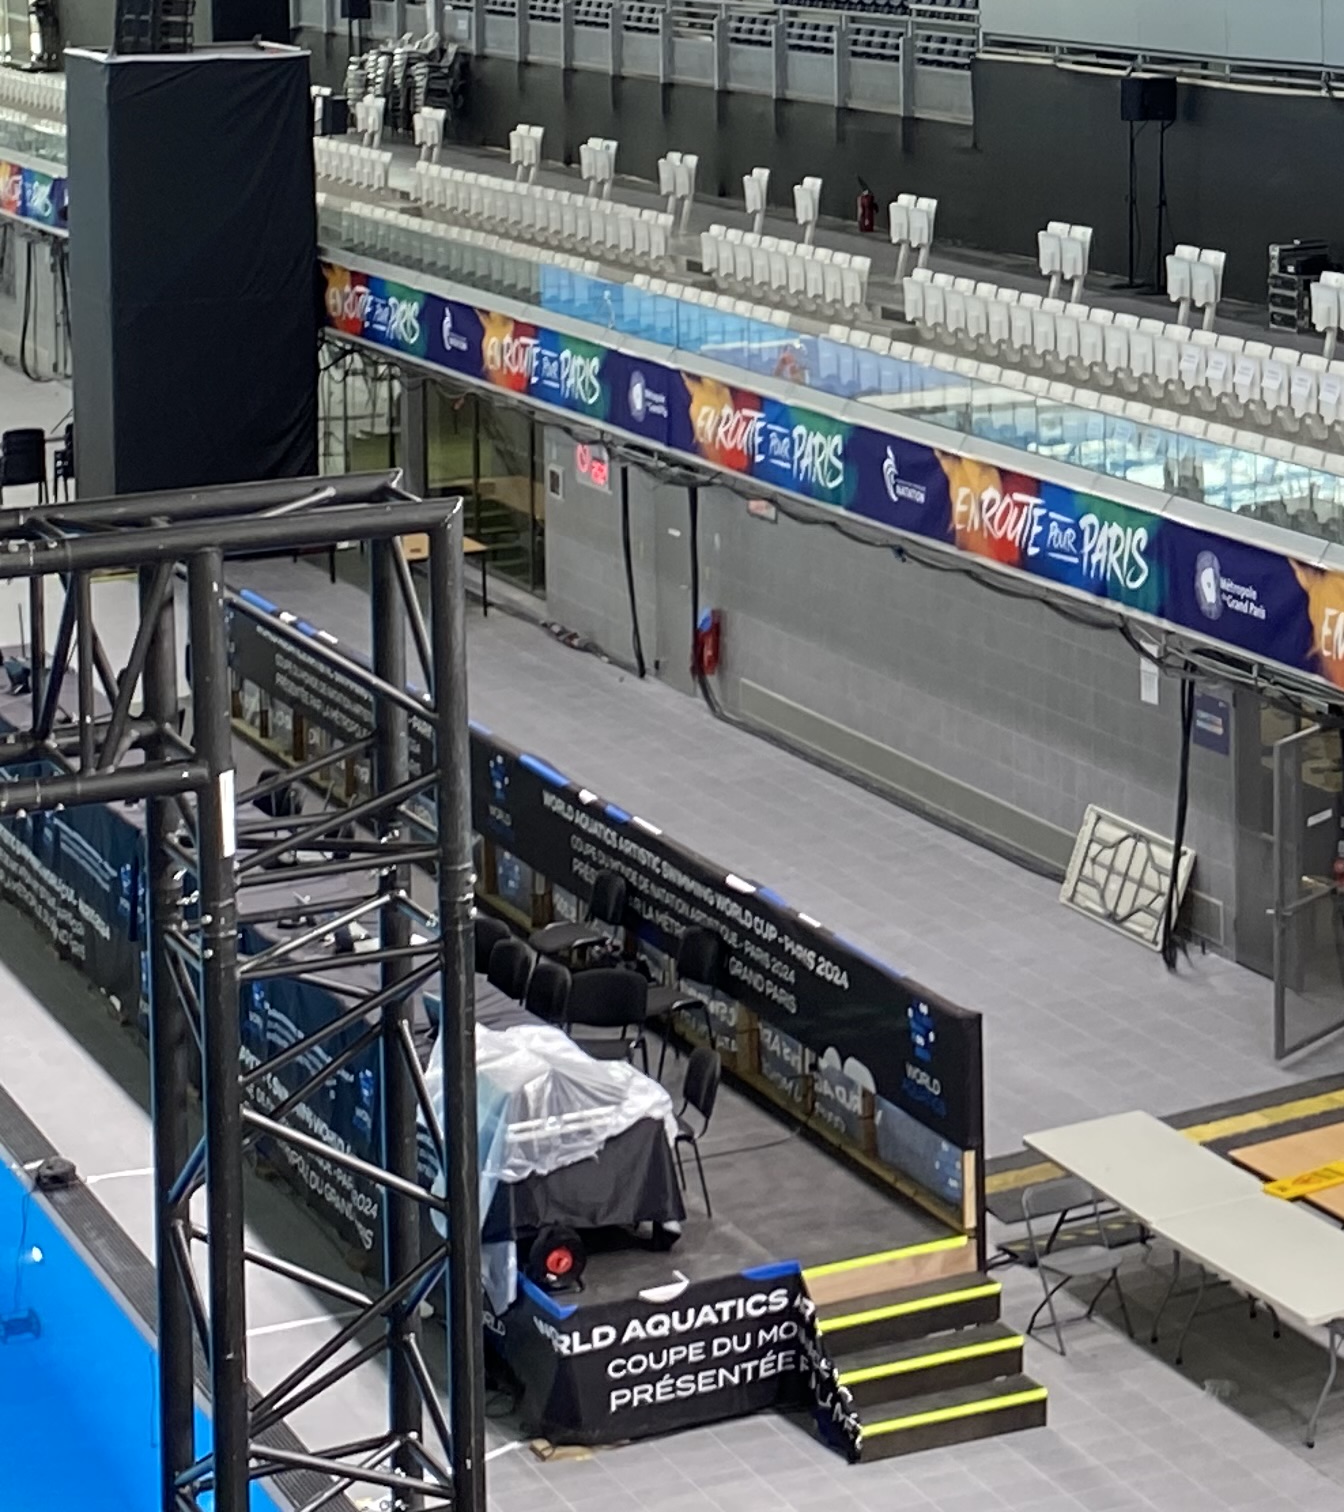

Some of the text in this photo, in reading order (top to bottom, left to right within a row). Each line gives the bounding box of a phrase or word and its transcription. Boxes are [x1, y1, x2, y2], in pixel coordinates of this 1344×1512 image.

[386, 297, 420, 344] PARIS
[502, 334, 541, 384] ROUTE
[559, 349, 600, 404] PARIS
[696, 406, 719, 444] EN
[714, 403, 767, 463] ROUTE
[791, 425, 844, 488] PARIS
[955, 486, 1149, 589] EN ROUTE POUR PARIS
[542, 789, 575, 823] WORLD
[715, 895, 754, 930] WORLD
[753, 915, 778, 943] CUP
[815, 953, 850, 991] 2024
[728, 955, 766, 992] GRAND
[764, 979, 798, 1014] PARIS
[905, 1061, 942, 1096] WORLD
[533, 1315, 617, 1357] WORLD
[620, 1287, 790, 1345] AQUATICS
[606, 1320, 799, 1380] COUPE DU MO
[608, 1349, 797, 1414] PRÉSENTÉE
